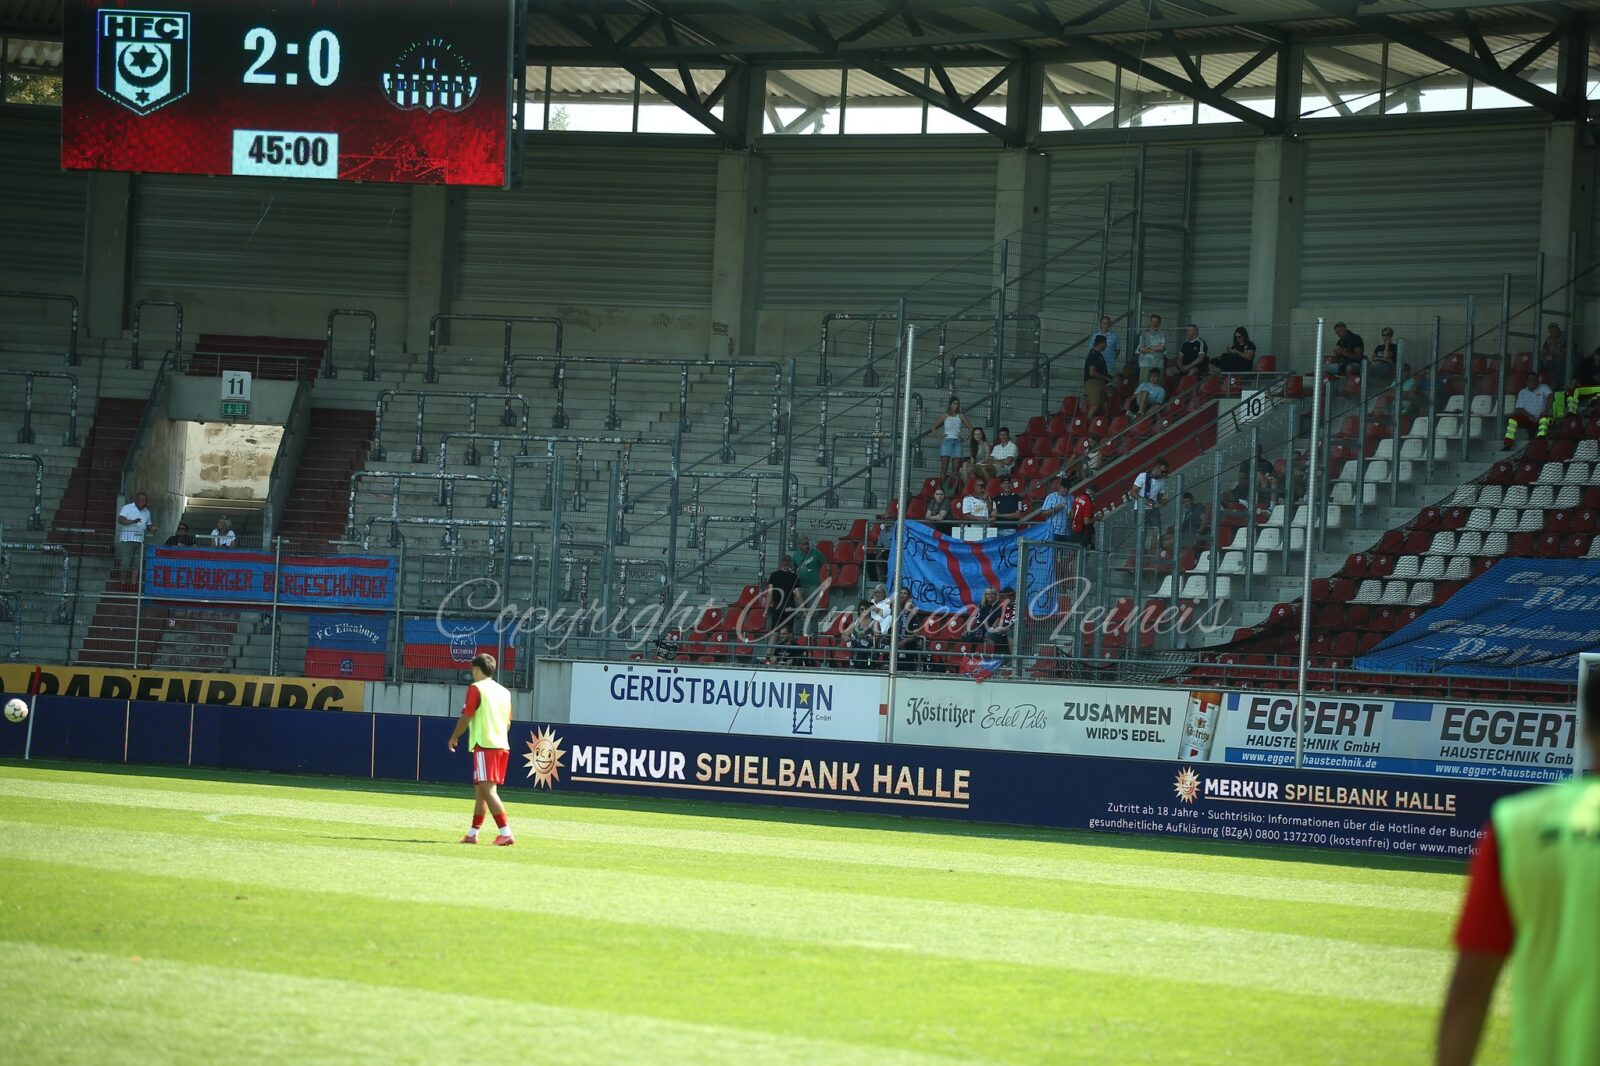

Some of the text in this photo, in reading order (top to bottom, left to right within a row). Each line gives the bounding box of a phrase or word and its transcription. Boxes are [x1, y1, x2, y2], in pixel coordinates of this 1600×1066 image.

[107, 17, 180, 39] HFC
[243, 27, 340, 87] 2:0
[248, 135, 329, 166] 45:00
[227, 378, 244, 395] 11
[1247, 398, 1262, 417] 10
[315, 626, 334, 641] FC
[980, 704, 1018, 730] Edel
[1014, 702, 1048, 730] Pils
[1063, 702, 1172, 726] ZUSAMMEN
[1247, 697, 1384, 737] EGGERT
[1131, 729, 1166, 743] EDEL.
[1440, 707, 1576, 749] EGGERT
[1241, 751, 1377, 769] www.eggerhaustechnik.de
[1343, 740, 1381, 754] GmbH
[1439, 746, 1574, 765] HAUSTECHNIK Gmb
[571, 745, 970, 800] MERKUR SPIELBANK HALLE
[1204, 778, 1456, 811] MERKUR SPIELBANK HALLE
[1107, 802, 1140, 814] Zutritt
[1142, 805, 1154, 815] ab
[1157, 806, 1169, 816] 18
[1171, 807, 1199, 818] Jahre
[1207, 810, 1265, 823] Suchtrisiko:
[1268, 814, 1340, 828] Informationen
[1343, 819, 1367, 831] über
[1369, 820, 1385, 832] die
[1388, 823, 1426, 835] Hotline
[1428, 825, 1447, 836] der
[1089, 817, 1164, 831] gesundheitliche
[1165, 822, 1219, 837] Aufklärung
[1221, 825, 1253, 840] (BZgA)
[1255, 830, 1280, 841] 0800
[1283, 831, 1327, 844] 1372700
[1329, 833, 1390, 850] (kostenfrei)
[1393, 840, 1416, 851] oder
